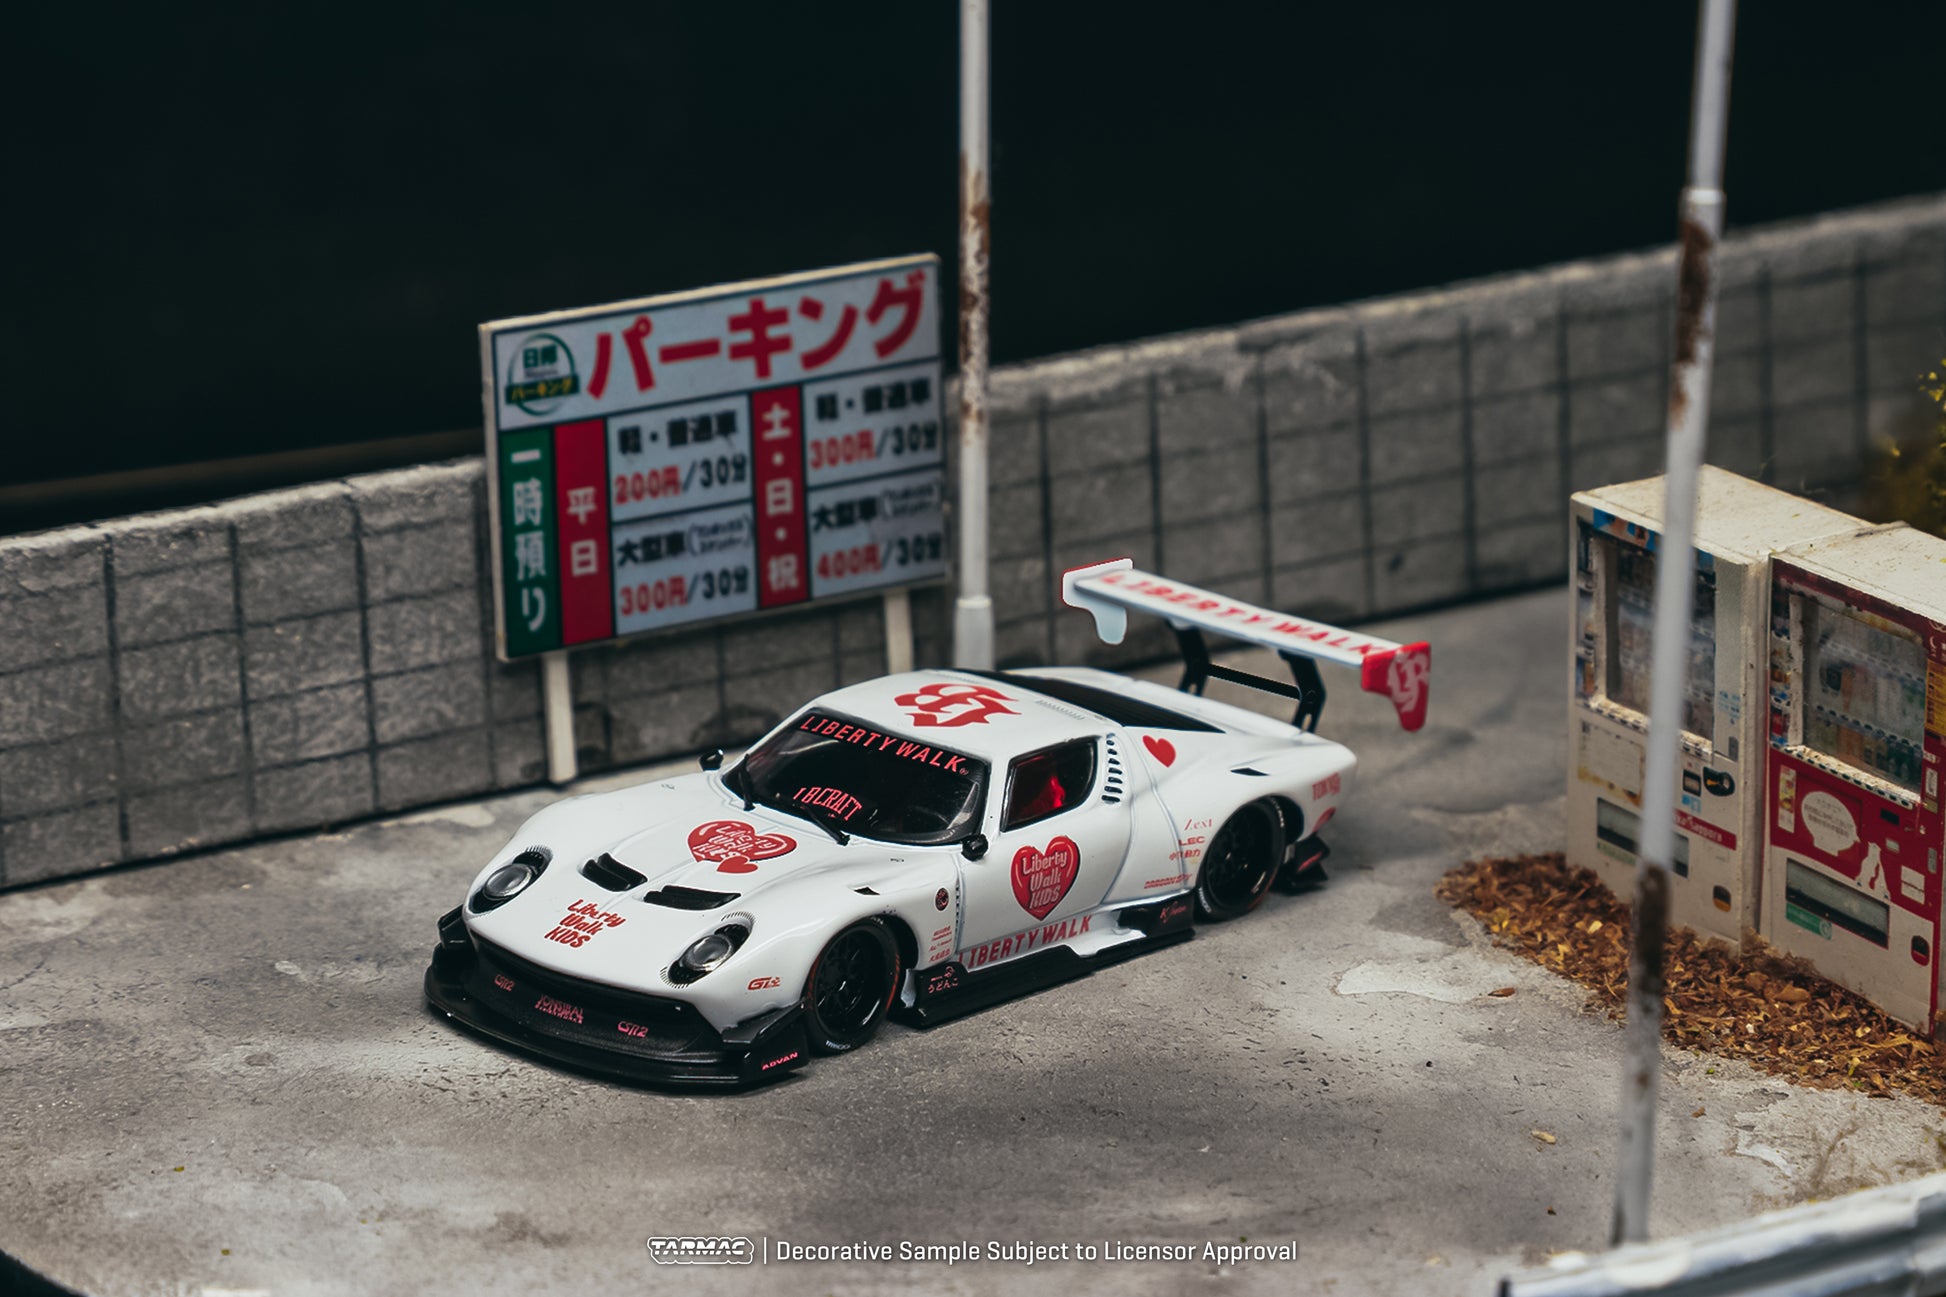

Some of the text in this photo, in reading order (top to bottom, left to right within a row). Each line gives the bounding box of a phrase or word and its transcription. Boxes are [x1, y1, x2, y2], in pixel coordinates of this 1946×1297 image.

[587, 269, 927, 399] パーキング
[511, 448, 547, 633] 一時預り
[566, 485, 598, 577] 平日
[1100, 574, 1386, 656] LIBERTY WALK
[799, 715, 897, 752] LIBERTY
[1021, 850, 1067, 875] Liberty
[1030, 868, 1062, 891] Walk
[1029, 886, 1061, 910] KIDS
[559, 913, 604, 936] Walk
[567, 899, 626, 928] Liberty
[544, 926, 592, 948] KIDS
[1042, 914, 1093, 943] WALK
[761, 1051, 798, 1071] ADVAN
